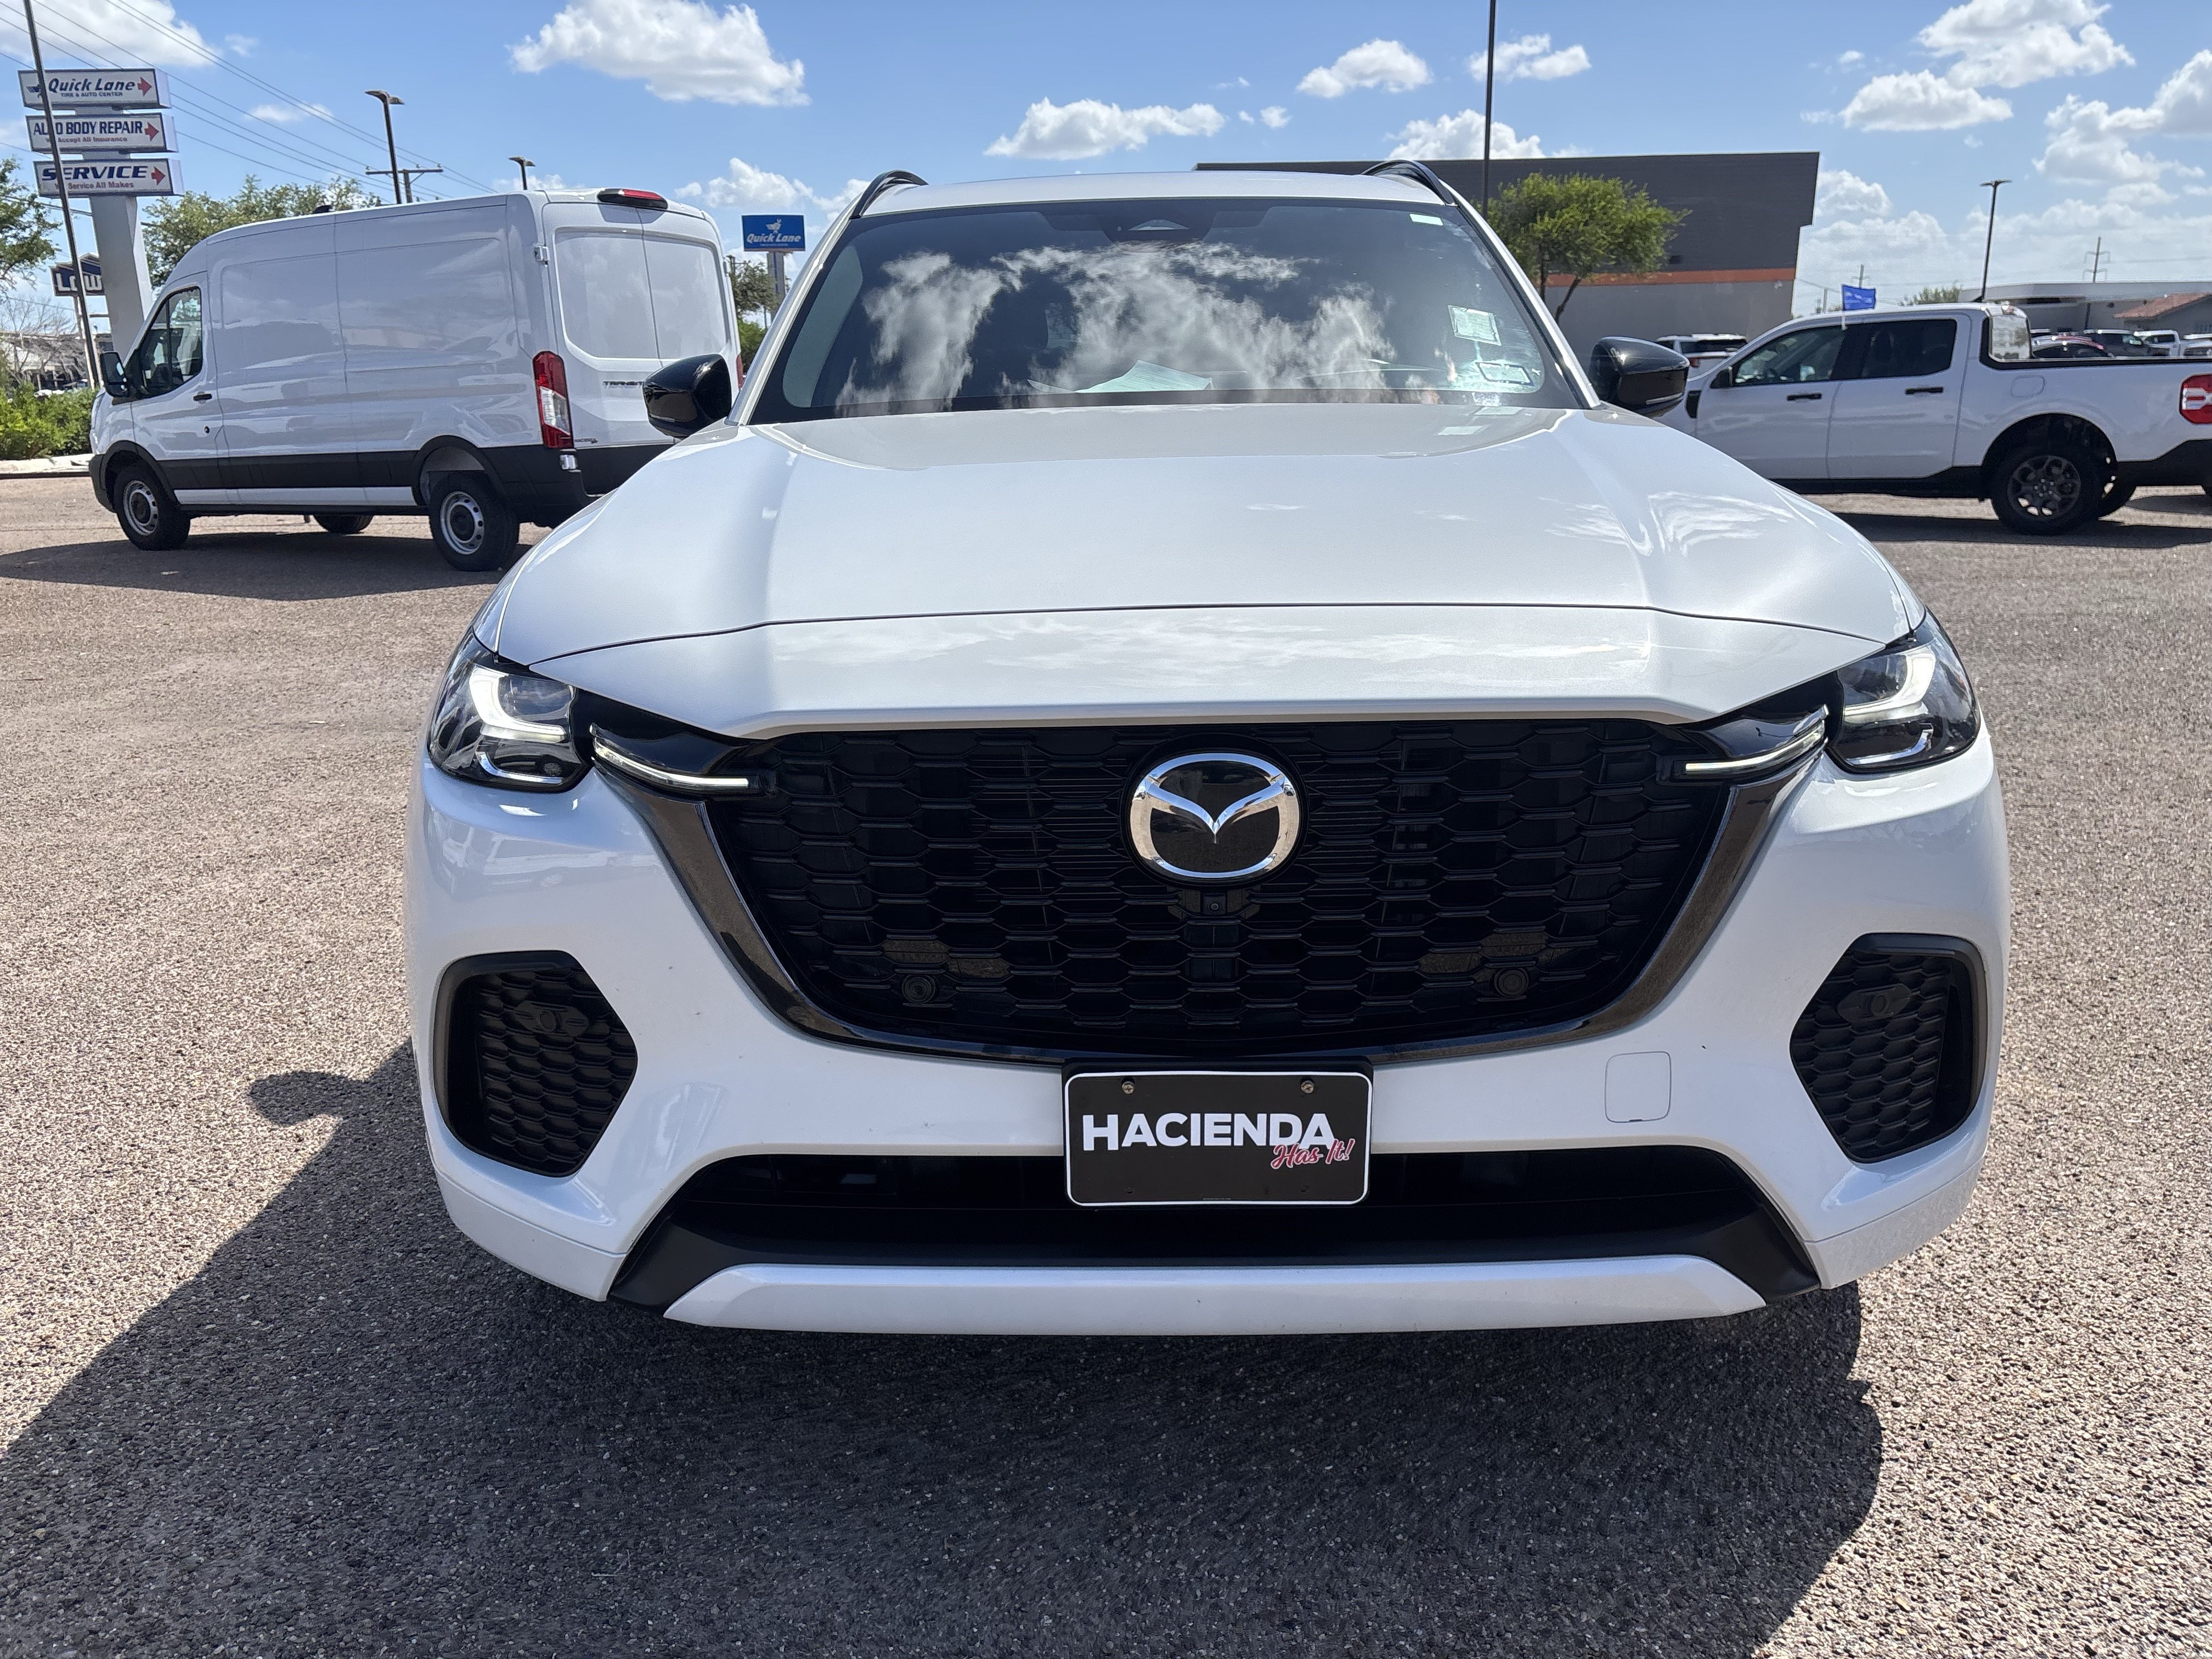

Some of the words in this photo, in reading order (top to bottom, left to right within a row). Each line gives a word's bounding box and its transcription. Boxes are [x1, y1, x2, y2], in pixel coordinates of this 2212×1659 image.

[48, 78, 92, 93] Quick
[95, 78, 135, 91] Lane
[33, 122, 63, 136] AUO
[65, 121, 97, 134] BODY
[99, 121, 143, 134] REPAIR
[42, 166, 148, 181] SERVICE
[747, 233, 775, 244] Quick
[775, 233, 802, 242] Lane
[55, 273, 103, 291] LOW
[1082, 1113, 1337, 1151] HACIENDA
[1271, 1143, 1323, 1169] Has
[1325, 1138, 1356, 1164] It!
